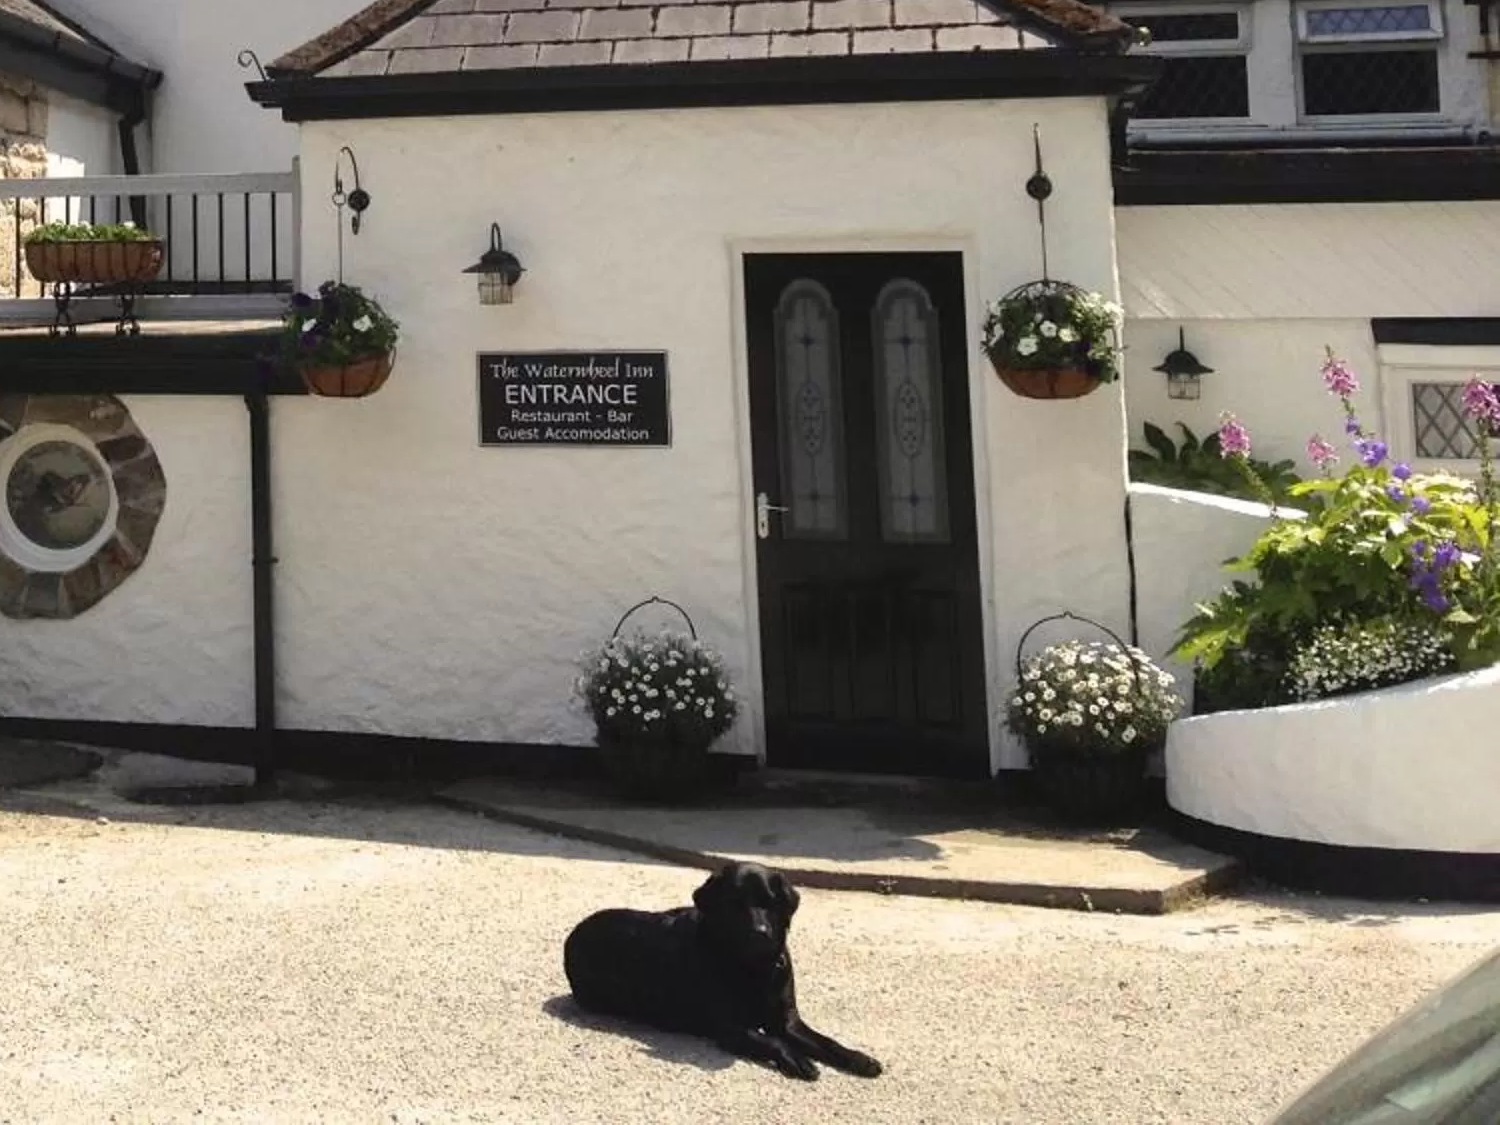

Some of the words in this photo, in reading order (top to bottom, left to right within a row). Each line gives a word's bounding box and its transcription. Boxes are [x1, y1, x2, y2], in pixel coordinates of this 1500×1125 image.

[489, 357, 519, 379] The
[524, 357, 620, 380] Waterwheel
[626, 362, 653, 378] Inn
[505, 384, 638, 405] ENTRANCE
[511, 409, 591, 423] Restaurant
[607, 409, 634, 423] Bar
[497, 426, 539, 440] Guest
[545, 426, 649, 440] Accomodation
